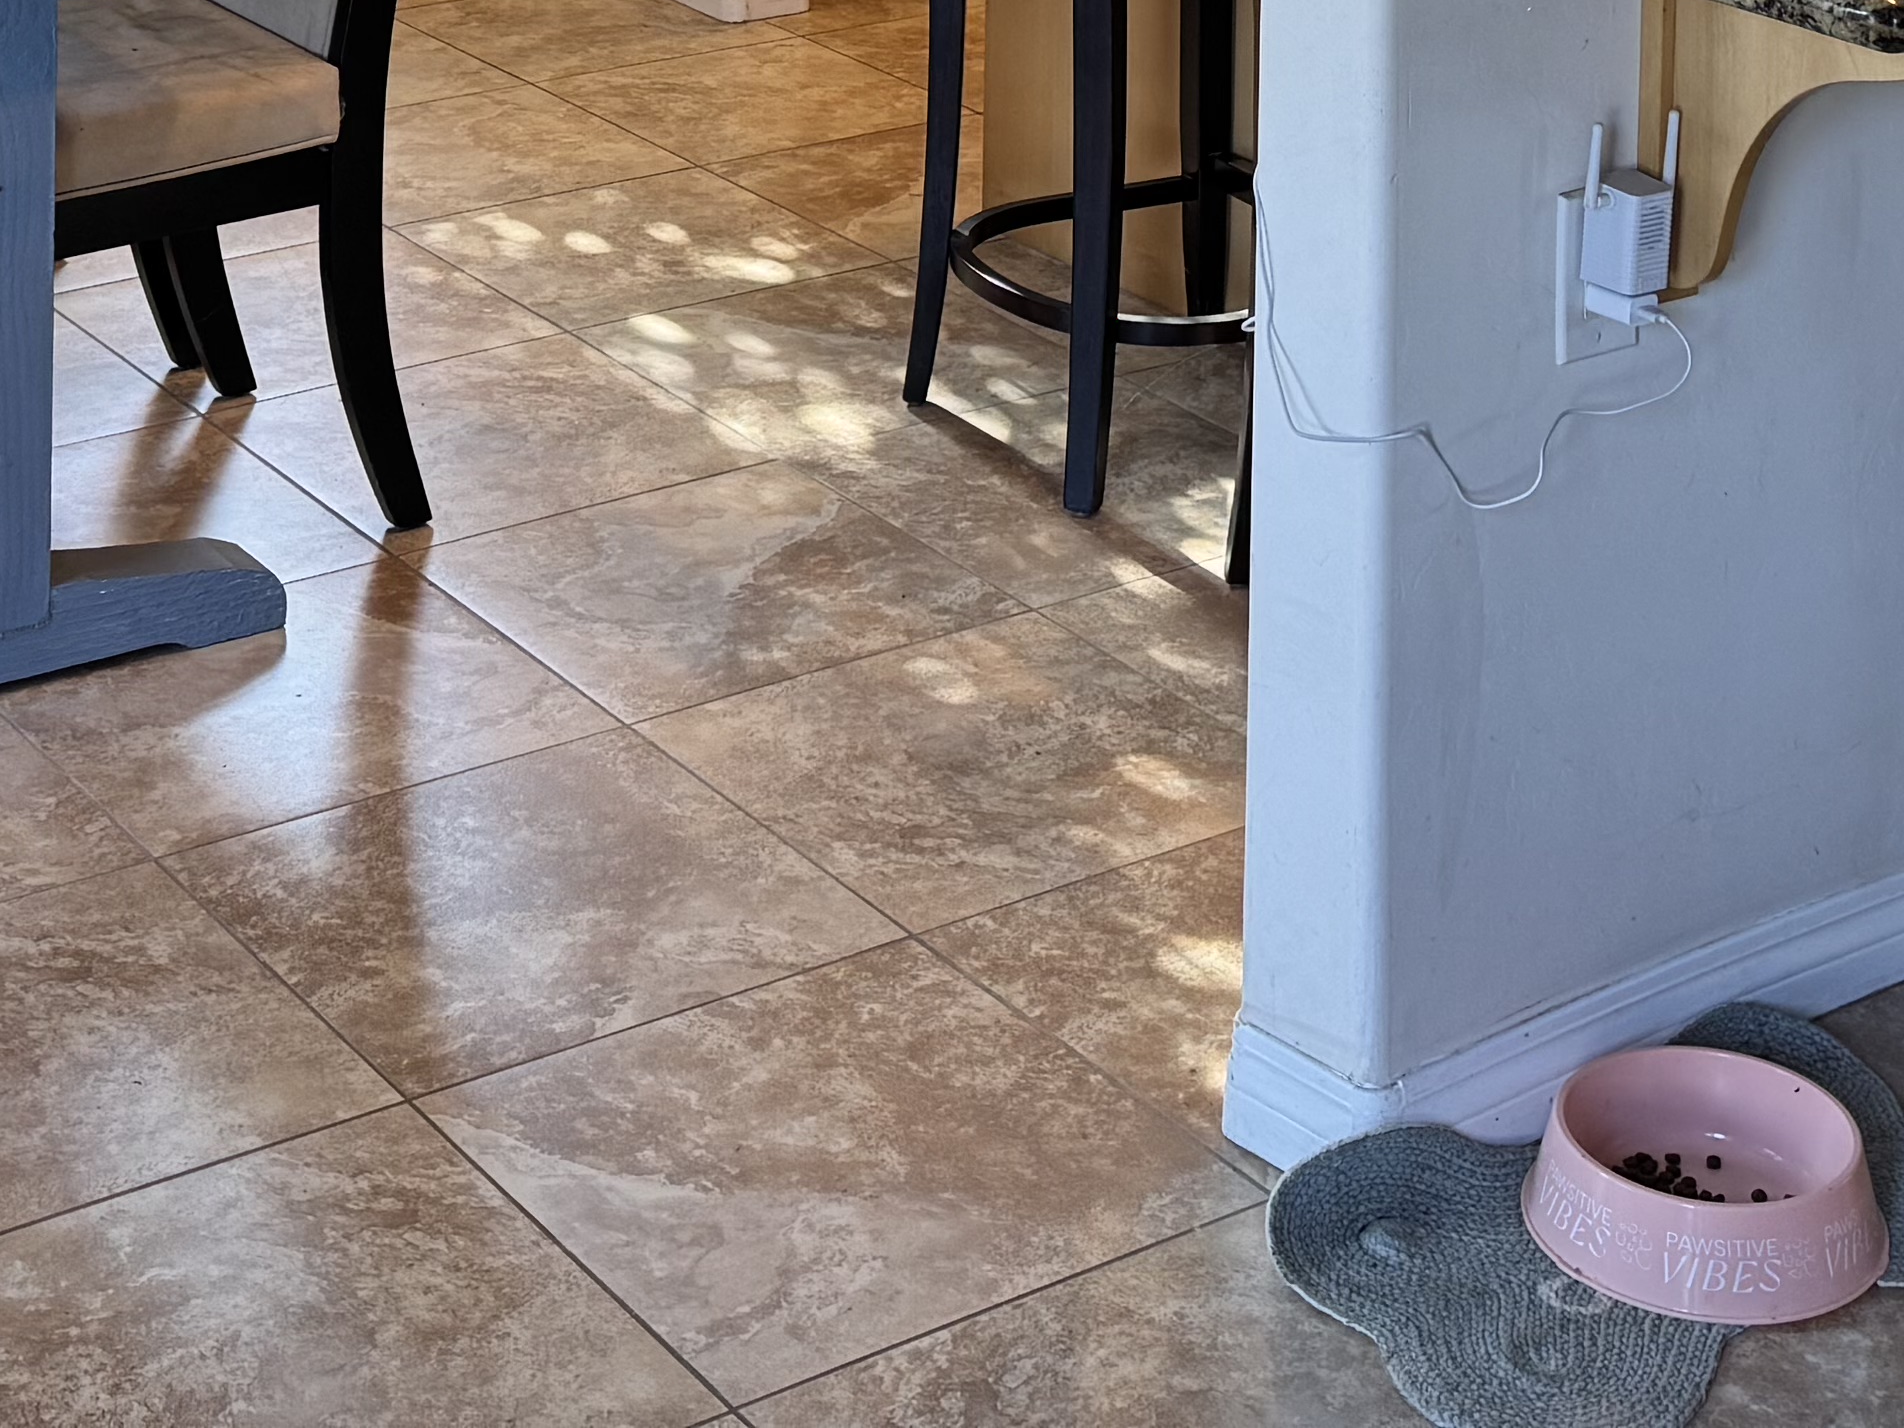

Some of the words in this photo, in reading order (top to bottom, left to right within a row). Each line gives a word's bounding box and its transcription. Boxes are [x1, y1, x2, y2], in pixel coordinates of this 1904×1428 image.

[1540, 1175, 1612, 1258] VIBES
[1665, 1231, 1779, 1259] PAWSITIVE
[1663, 1251, 1781, 1294] VIBES
